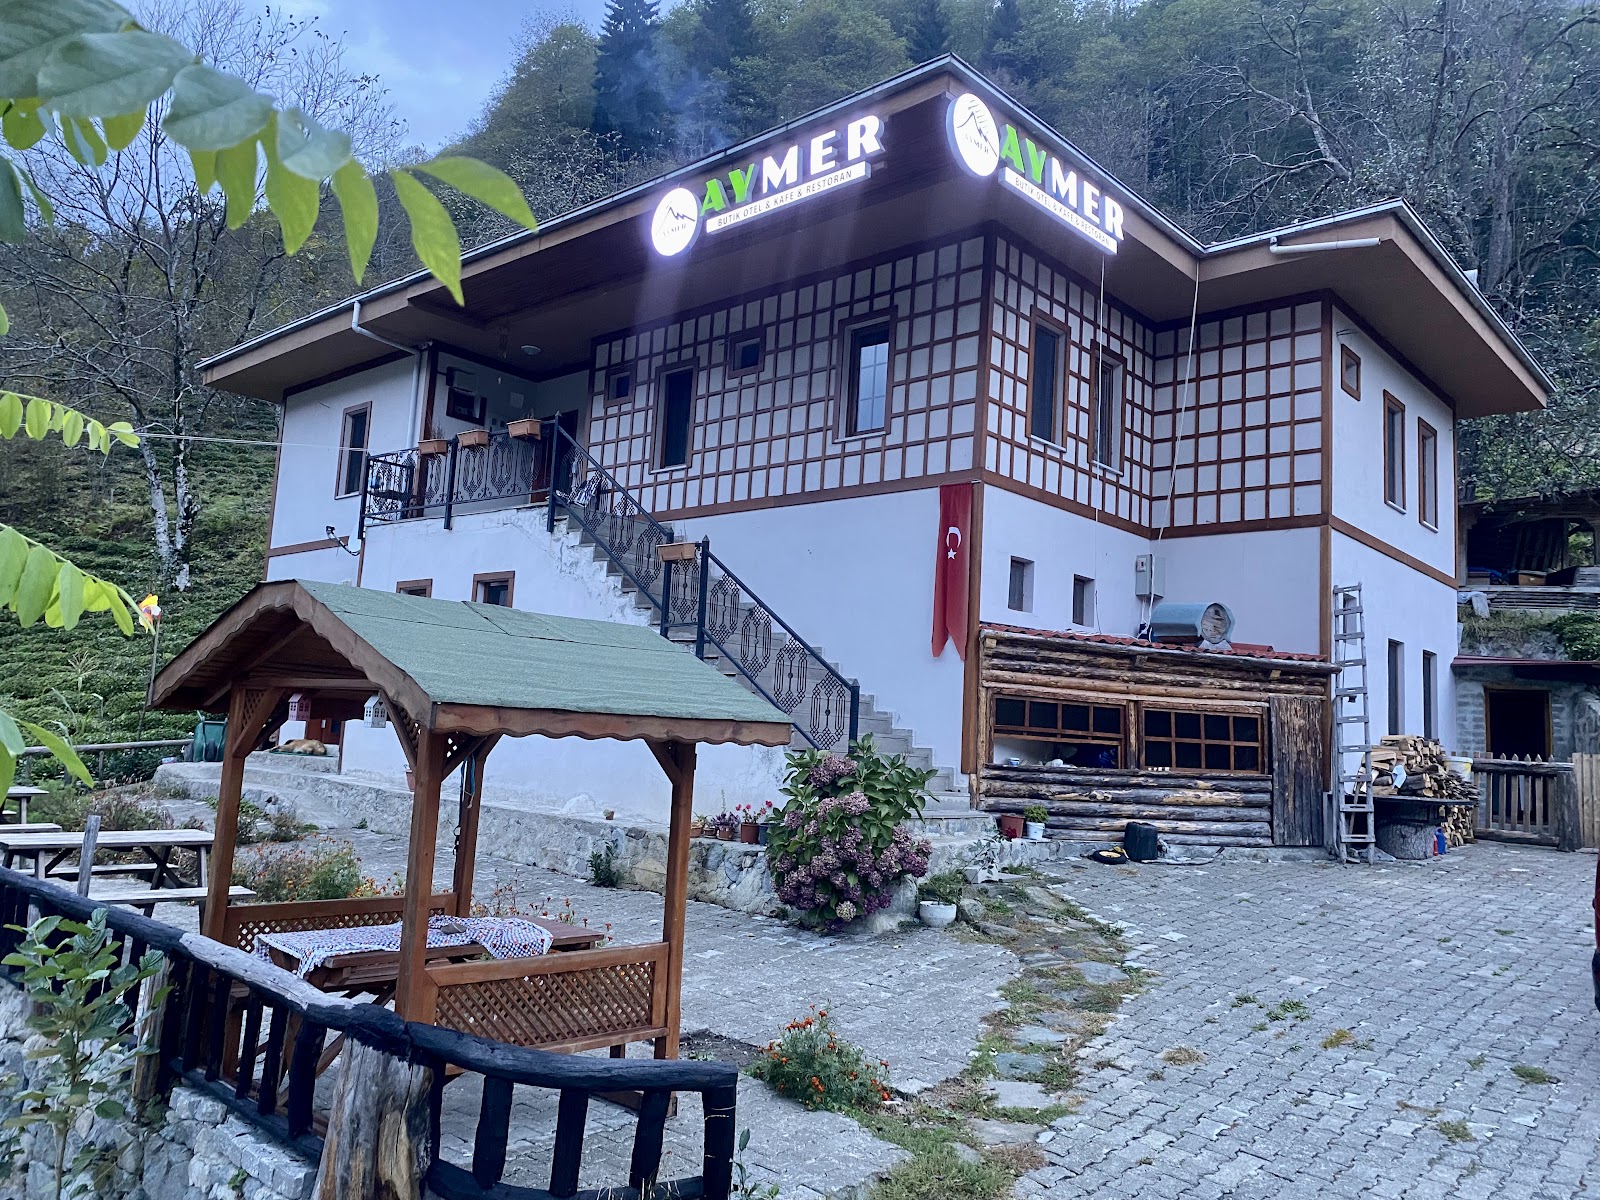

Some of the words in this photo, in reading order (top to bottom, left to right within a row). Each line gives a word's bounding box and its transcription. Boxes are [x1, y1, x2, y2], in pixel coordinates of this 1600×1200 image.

[701, 115, 883, 217] AYMER
[717, 212, 741, 227] BUTIK
[743, 204, 762, 218] OTEL
[765, 200, 771, 209] &
[773, 194, 794, 206] KAFE
[797, 189, 803, 198] &
[806, 170, 852, 193] RESTORAN
[1000, 123, 1124, 241] AYMER
[1015, 177, 1034, 196] BUTIK
[1036, 190, 1051, 207] OTEL
[1059, 205, 1074, 223] KAFE
[1081, 221, 1110, 246] RESTORAN
